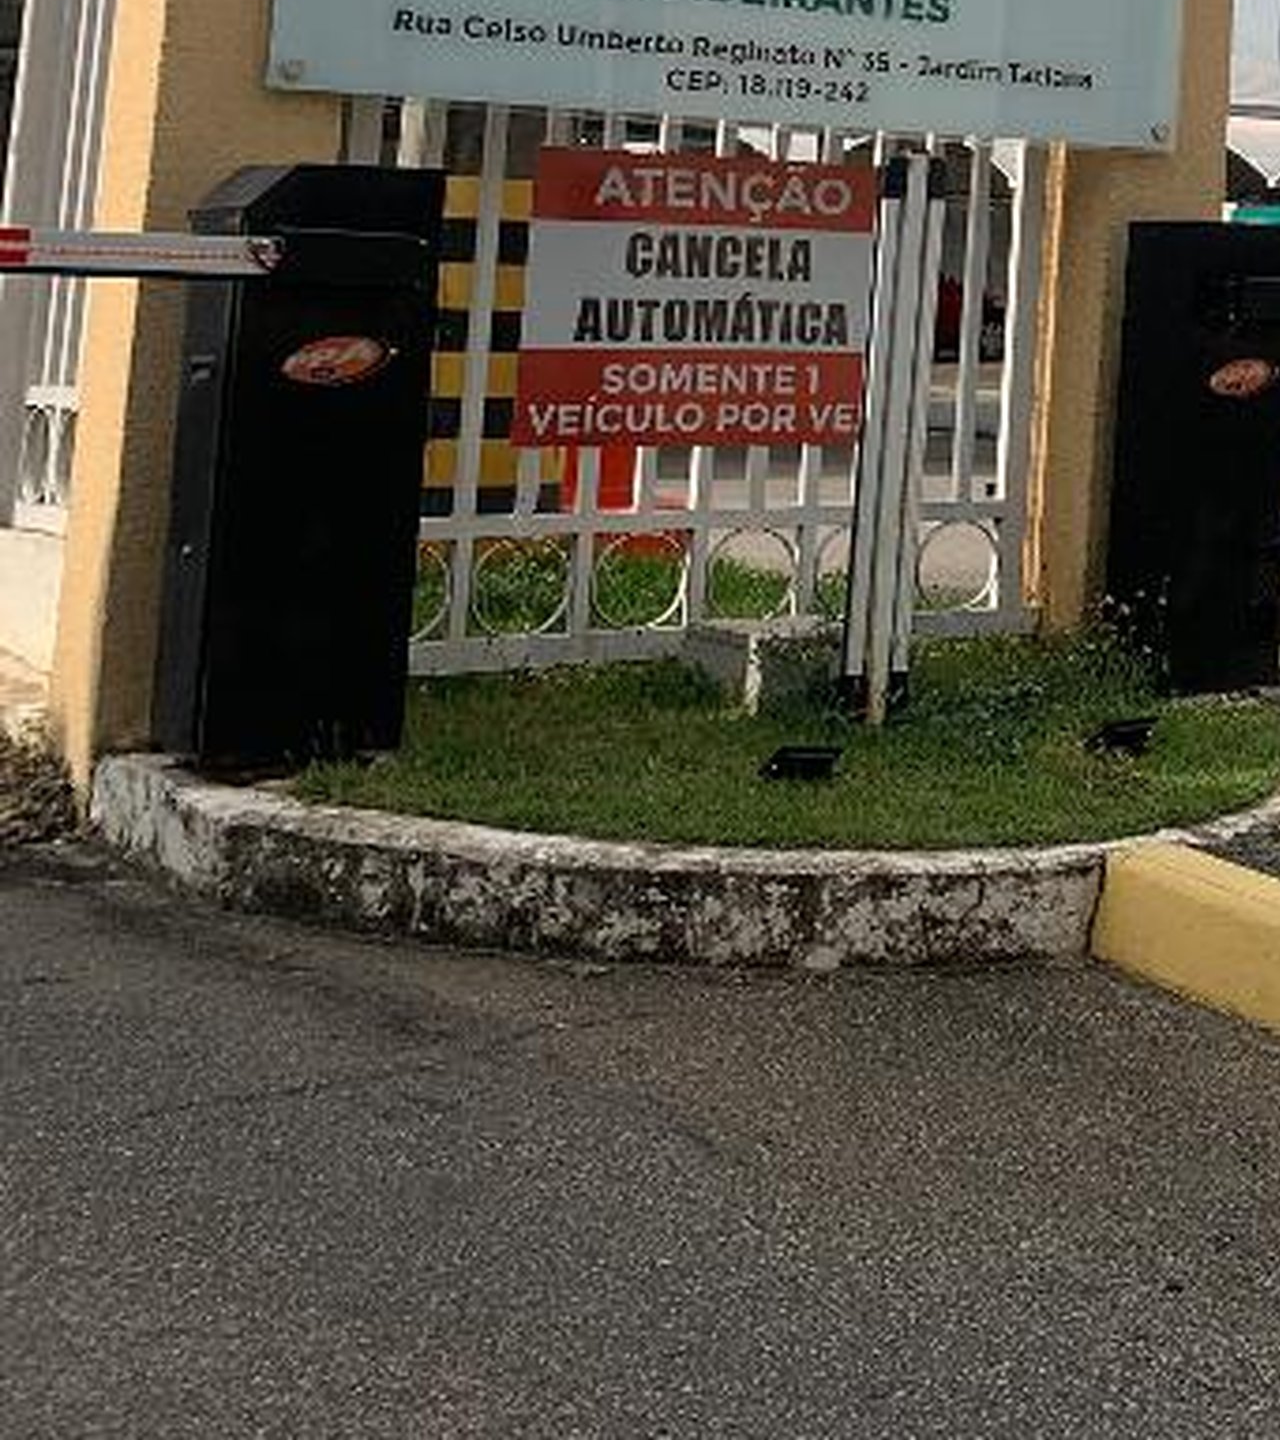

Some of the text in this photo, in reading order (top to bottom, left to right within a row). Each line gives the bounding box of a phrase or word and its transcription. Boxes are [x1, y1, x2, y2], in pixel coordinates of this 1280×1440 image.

[393, 9, 451, 36] Rua
[595, 162, 853, 224] ATENÇÃO
[626, 232, 813, 282] CANCELA
[574, 291, 850, 347] AUTOMÁTICA
[602, 363, 821, 396] SOMENTE 1
[528, 394, 863, 437] VEÍCULO POR VE
